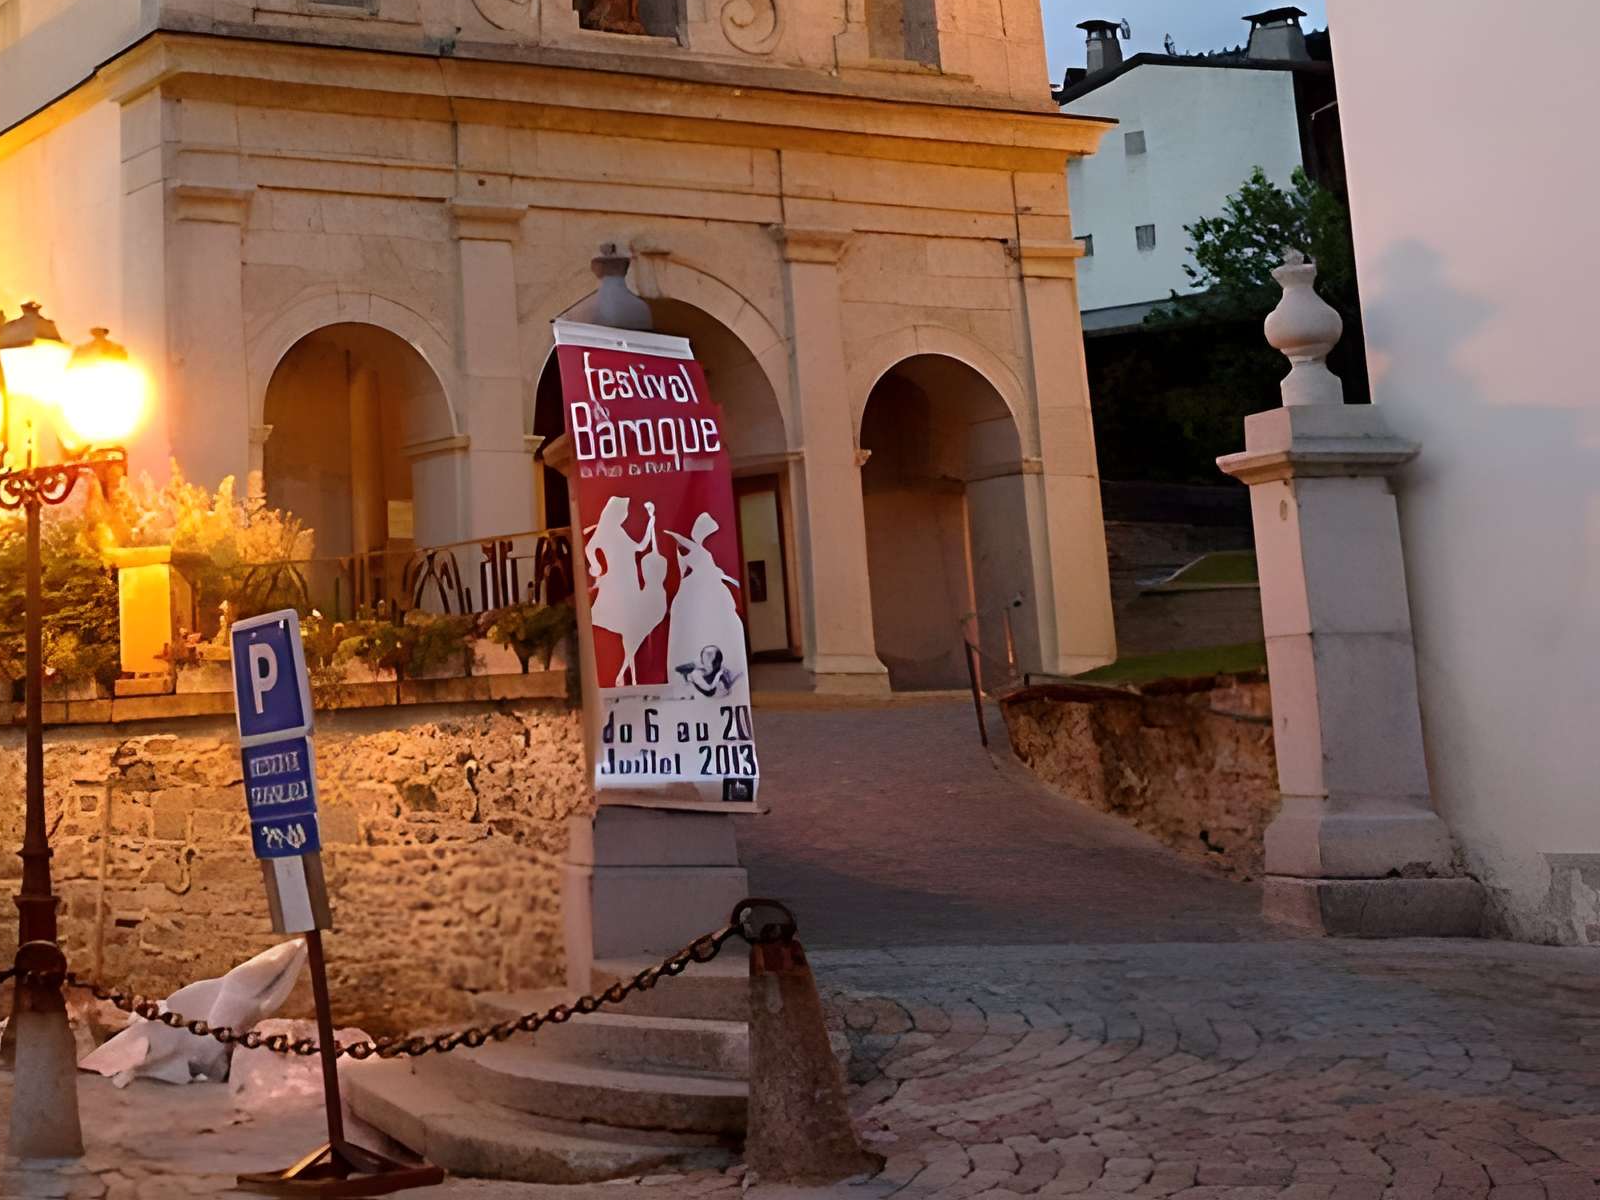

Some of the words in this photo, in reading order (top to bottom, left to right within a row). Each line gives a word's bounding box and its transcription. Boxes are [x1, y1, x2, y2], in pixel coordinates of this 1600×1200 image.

[571, 402, 721, 471] Baroque
[248, 642, 278, 714] P
[644, 708, 659, 743] 6
[677, 721, 709, 743] au
[720, 705, 752, 741] 20
[699, 744, 757, 776] 2013
